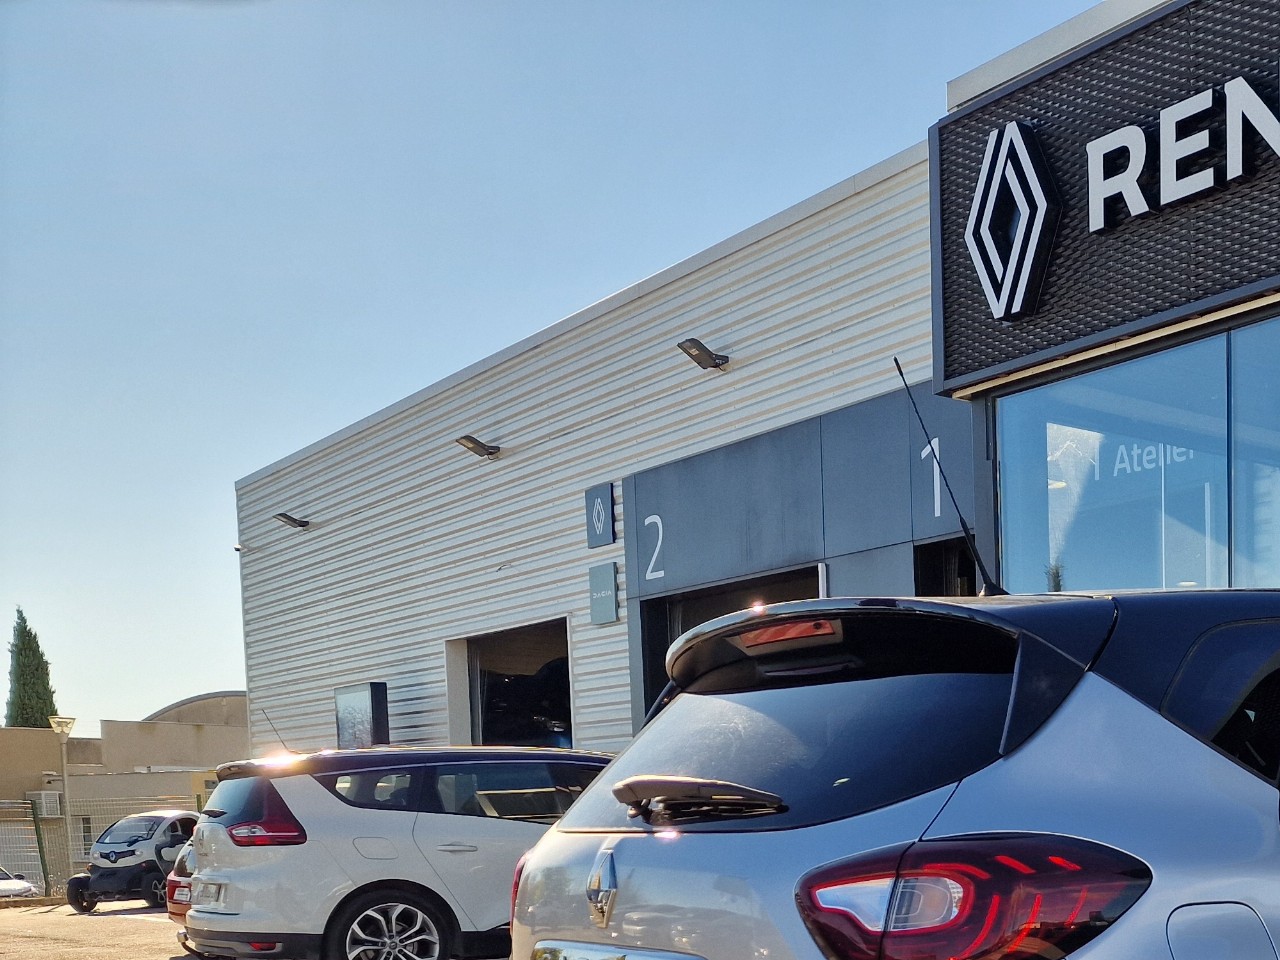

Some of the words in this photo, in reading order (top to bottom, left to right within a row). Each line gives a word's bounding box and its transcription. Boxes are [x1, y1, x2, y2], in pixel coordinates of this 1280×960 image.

[920, 437, 941, 518] 1
[643, 513, 665, 581] 2
[592, 589, 612, 600] DACIA
